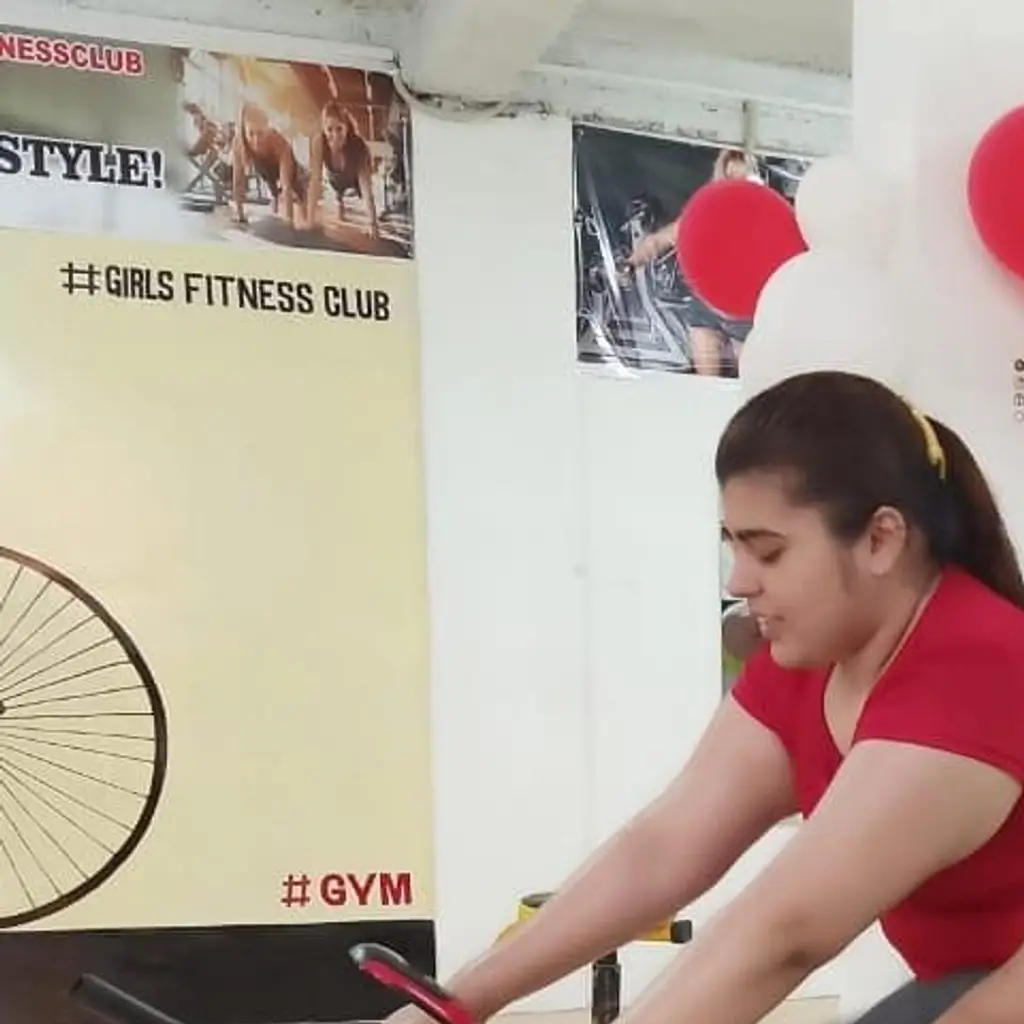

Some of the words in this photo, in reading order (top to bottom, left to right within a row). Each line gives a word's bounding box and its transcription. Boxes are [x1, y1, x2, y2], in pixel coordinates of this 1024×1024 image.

[0, 134, 163, 189] STYLE!
[183, 273, 314, 314] FITNESS
[323, 285, 391, 321] CLUB
